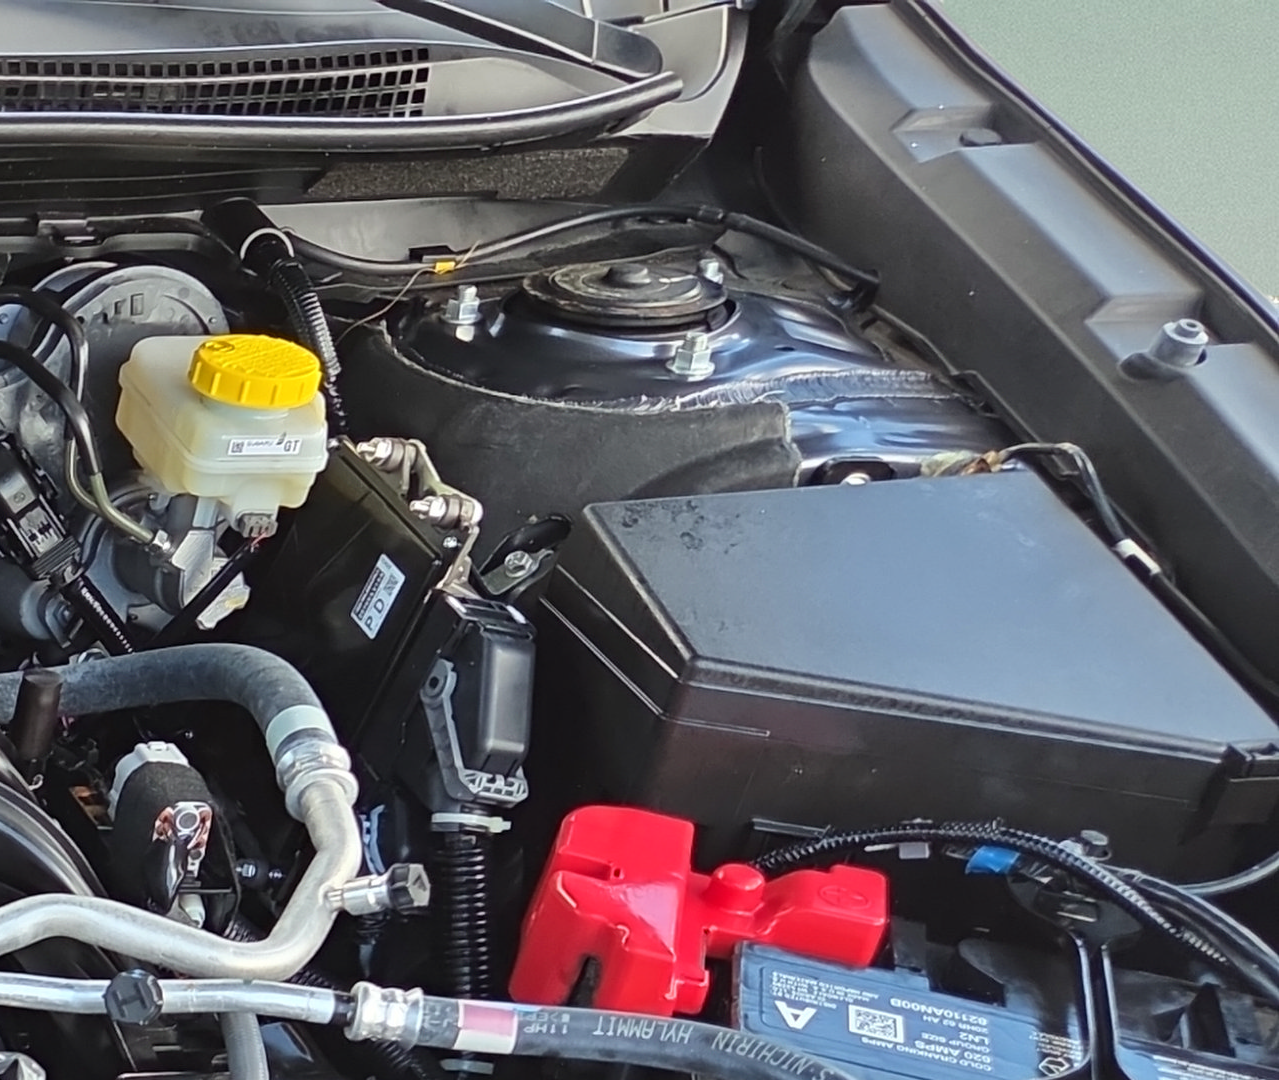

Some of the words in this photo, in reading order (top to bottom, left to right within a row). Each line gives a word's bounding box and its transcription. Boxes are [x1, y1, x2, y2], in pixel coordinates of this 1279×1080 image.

[284, 440, 299, 452] GT
[364, 615, 377, 631] P
[373, 597, 386, 614] D
[113, 982, 147, 1017] H
[775, 1000, 817, 1029] A
[592, 1015, 694, 1045] HYLAMMIT
[921, 1032, 945, 1043] SIZE
[958, 1031, 988, 1044] LN2
[861, 1035, 894, 1049] AMPS
[914, 1039, 959, 1056] AMPS
[896, 1043, 956, 1064] CRANKING
[964, 1050, 990, 1063] 620
[959, 1057, 992, 1071] COLD
